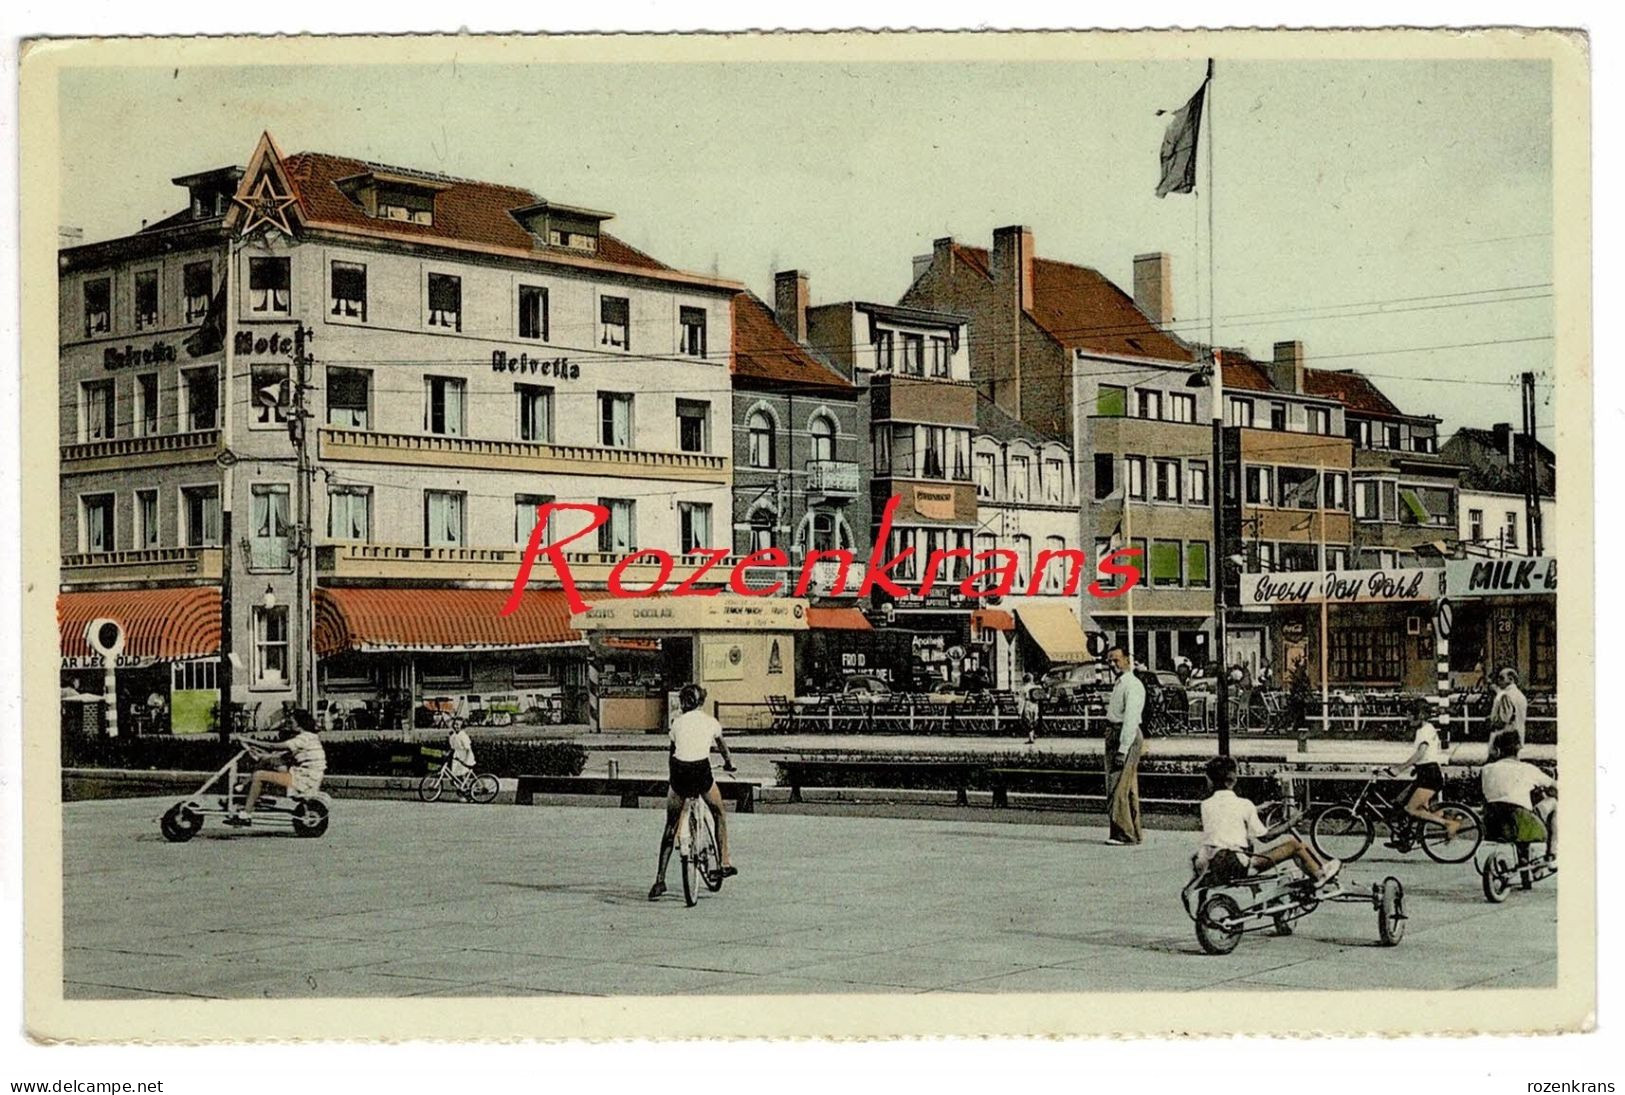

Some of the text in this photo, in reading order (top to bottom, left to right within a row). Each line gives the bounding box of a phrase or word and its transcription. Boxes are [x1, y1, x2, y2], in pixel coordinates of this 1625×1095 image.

[493, 350, 580, 380] Helvetia
[1254, 575, 1314, 603] Every
[1321, 572, 1363, 600] Day
[1368, 571, 1424, 599] Park
[1498, 621, 1512, 632] 28
[83, 656, 140, 668] LEOOLD
